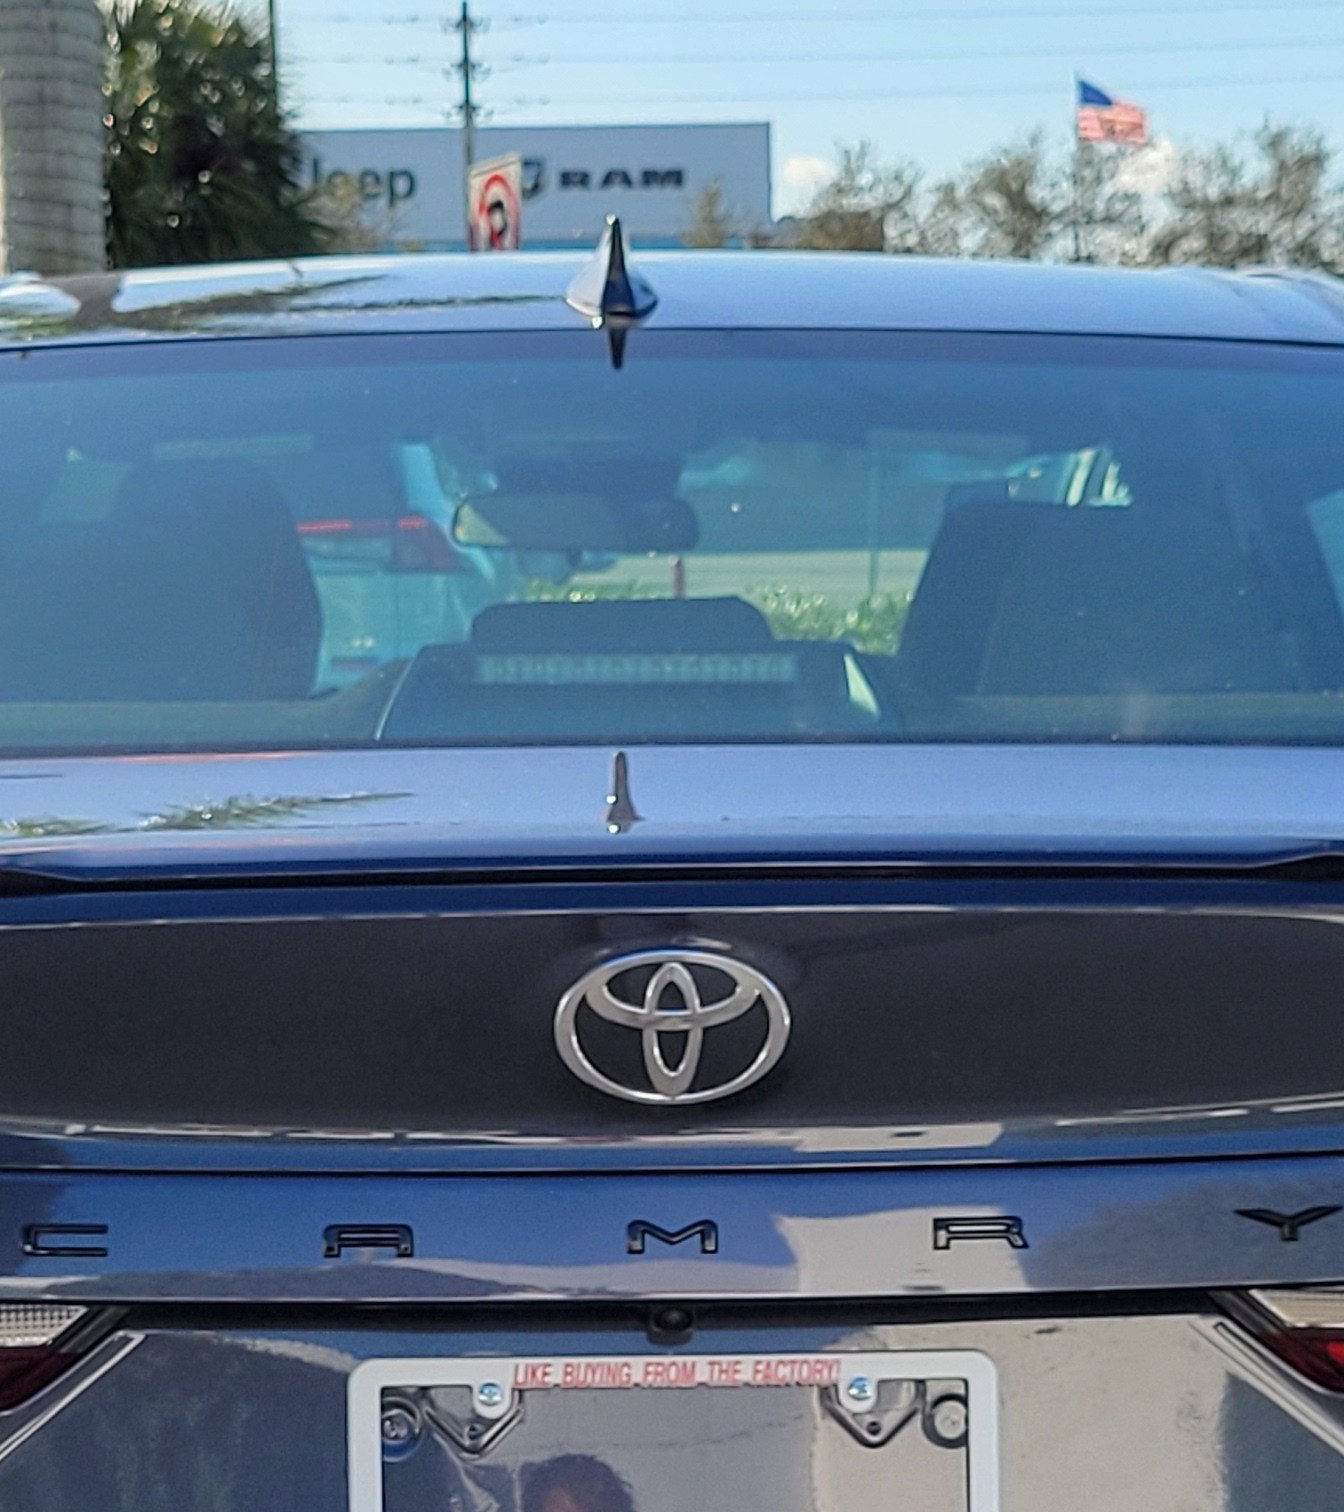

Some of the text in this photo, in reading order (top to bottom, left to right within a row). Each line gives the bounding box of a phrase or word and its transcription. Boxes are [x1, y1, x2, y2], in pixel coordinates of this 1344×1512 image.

[560, 169, 684, 190] RAM
[513, 1363, 552, 1387] LIKE
[561, 1362, 632, 1386] BUYING
[642, 1361, 697, 1385] FROM
[707, 1360, 742, 1383] THE
